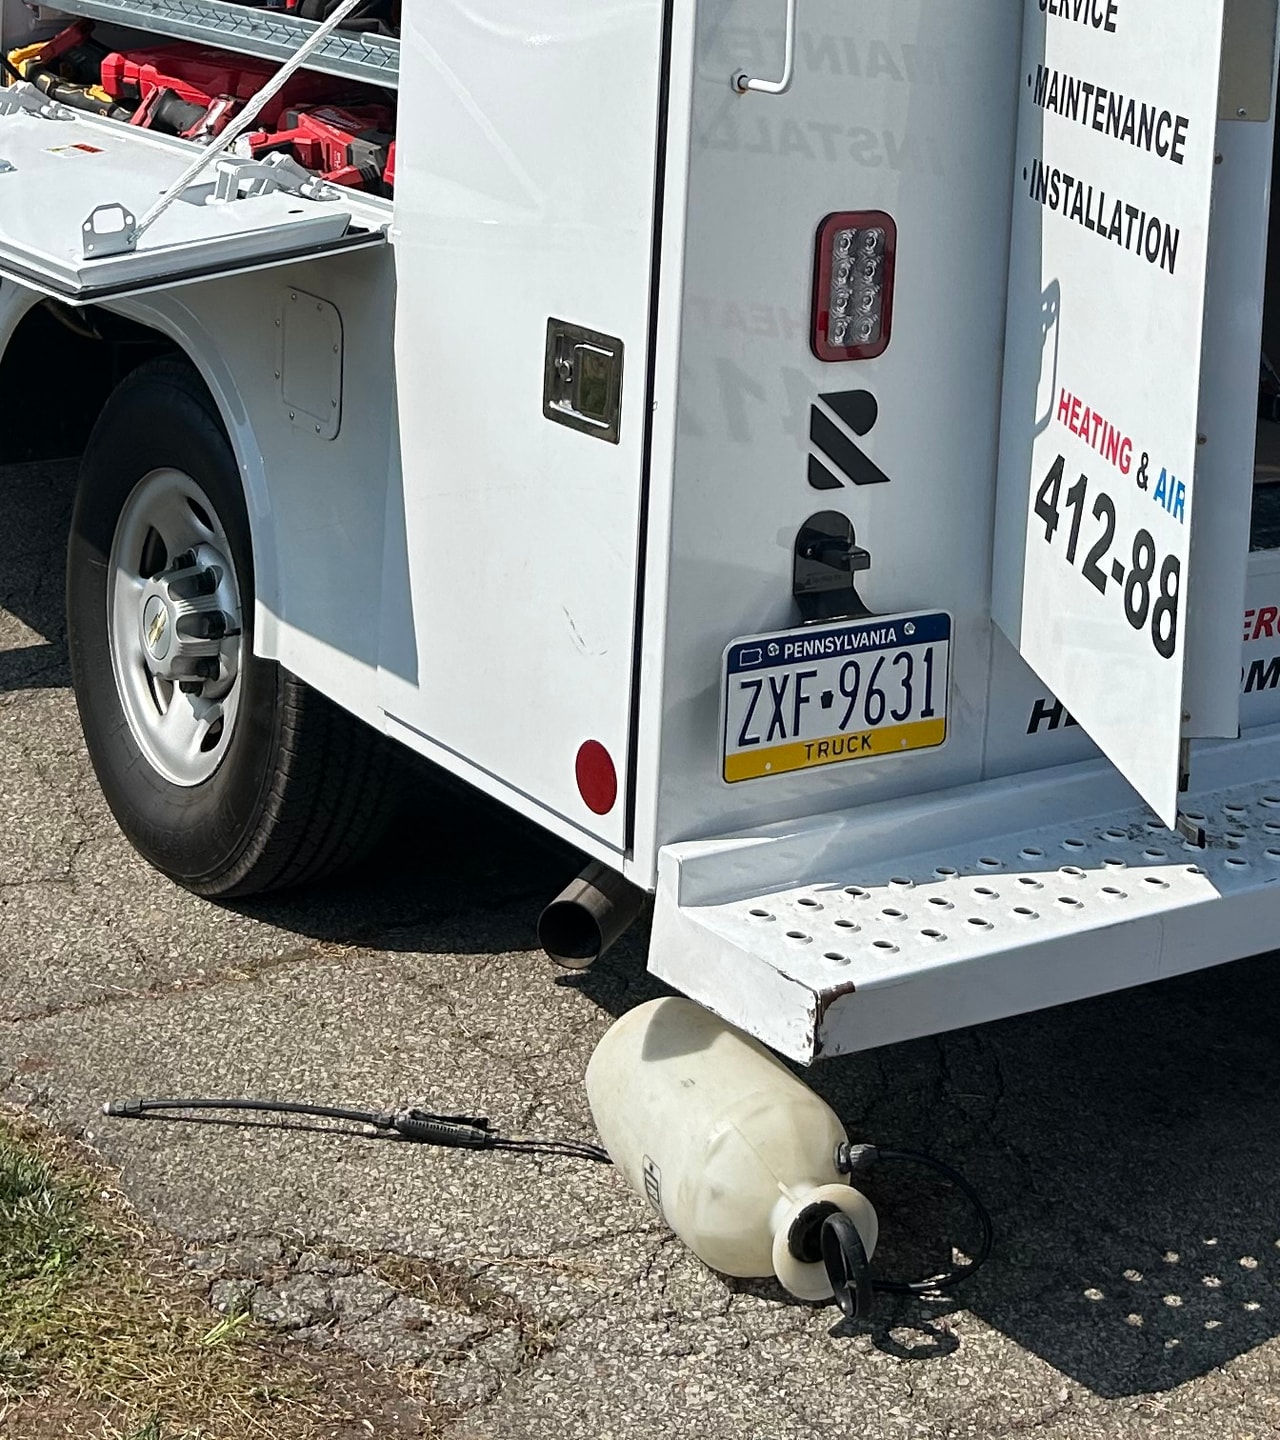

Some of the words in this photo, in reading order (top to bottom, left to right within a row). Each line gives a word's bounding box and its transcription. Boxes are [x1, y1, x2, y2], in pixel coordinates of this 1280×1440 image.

[1032, 63, 1190, 166] MAINTENANCE
[1028, 158, 1180, 275] INSTALLATION
[1056, 387, 1134, 475] HEATING
[1136, 451, 1150, 492] &
[1152, 467, 1187, 525] AIR
[1033, 453, 1182, 660] 412-88
[783, 626, 897, 660] PENNSYLVANIA
[803, 732, 873, 762] TRUCK
